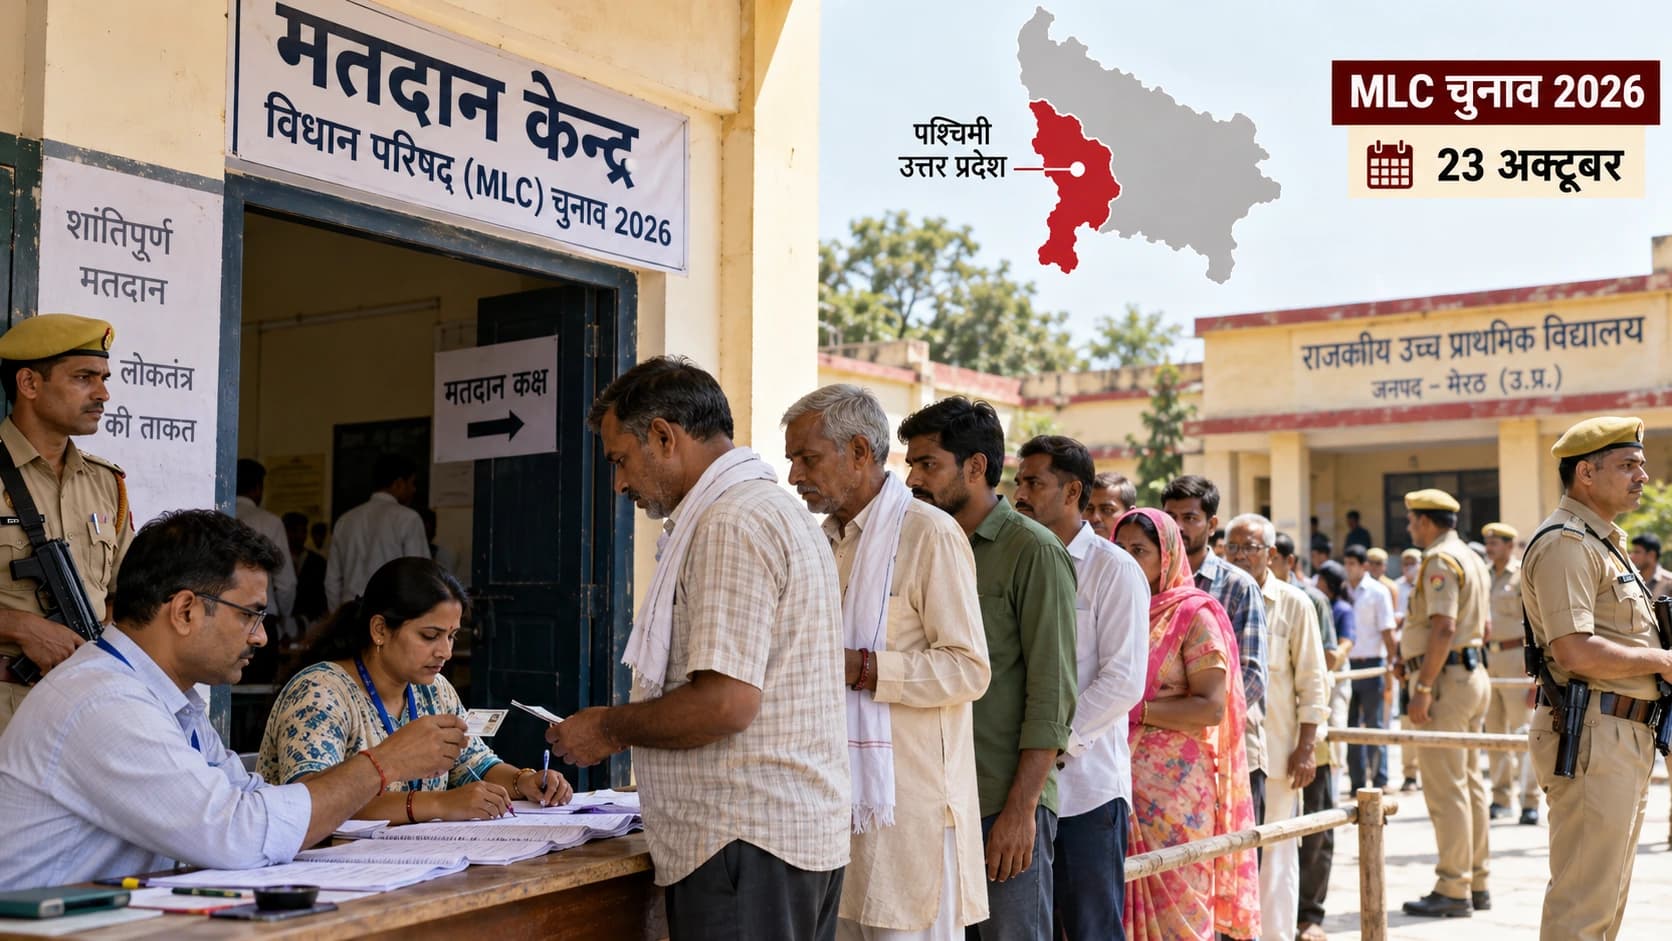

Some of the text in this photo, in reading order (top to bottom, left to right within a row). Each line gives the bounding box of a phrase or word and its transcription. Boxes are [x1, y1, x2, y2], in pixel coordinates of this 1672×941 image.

[276, 2, 639, 189] मतदान केन्द्र
[264, 91, 672, 247] विधान परिषद् (MLC) चुनाव 2026
[66, 206, 174, 262] शांतिपूर्ण
[79, 265, 169, 305] मतदान
[1399, 335, 1442, 362] उच्च
[1448, 319, 1536, 359] प्राथमिक
[1543, 314, 1645, 351] विद्यालय
[120, 352, 195, 391] लोकतंत्र
[443, 368, 549, 406] मतदान कक्ष
[1371, 378, 1423, 400] जनपद
[1446, 368, 1488, 395] मेरठ
[104, 406, 197, 443] की ताकत
